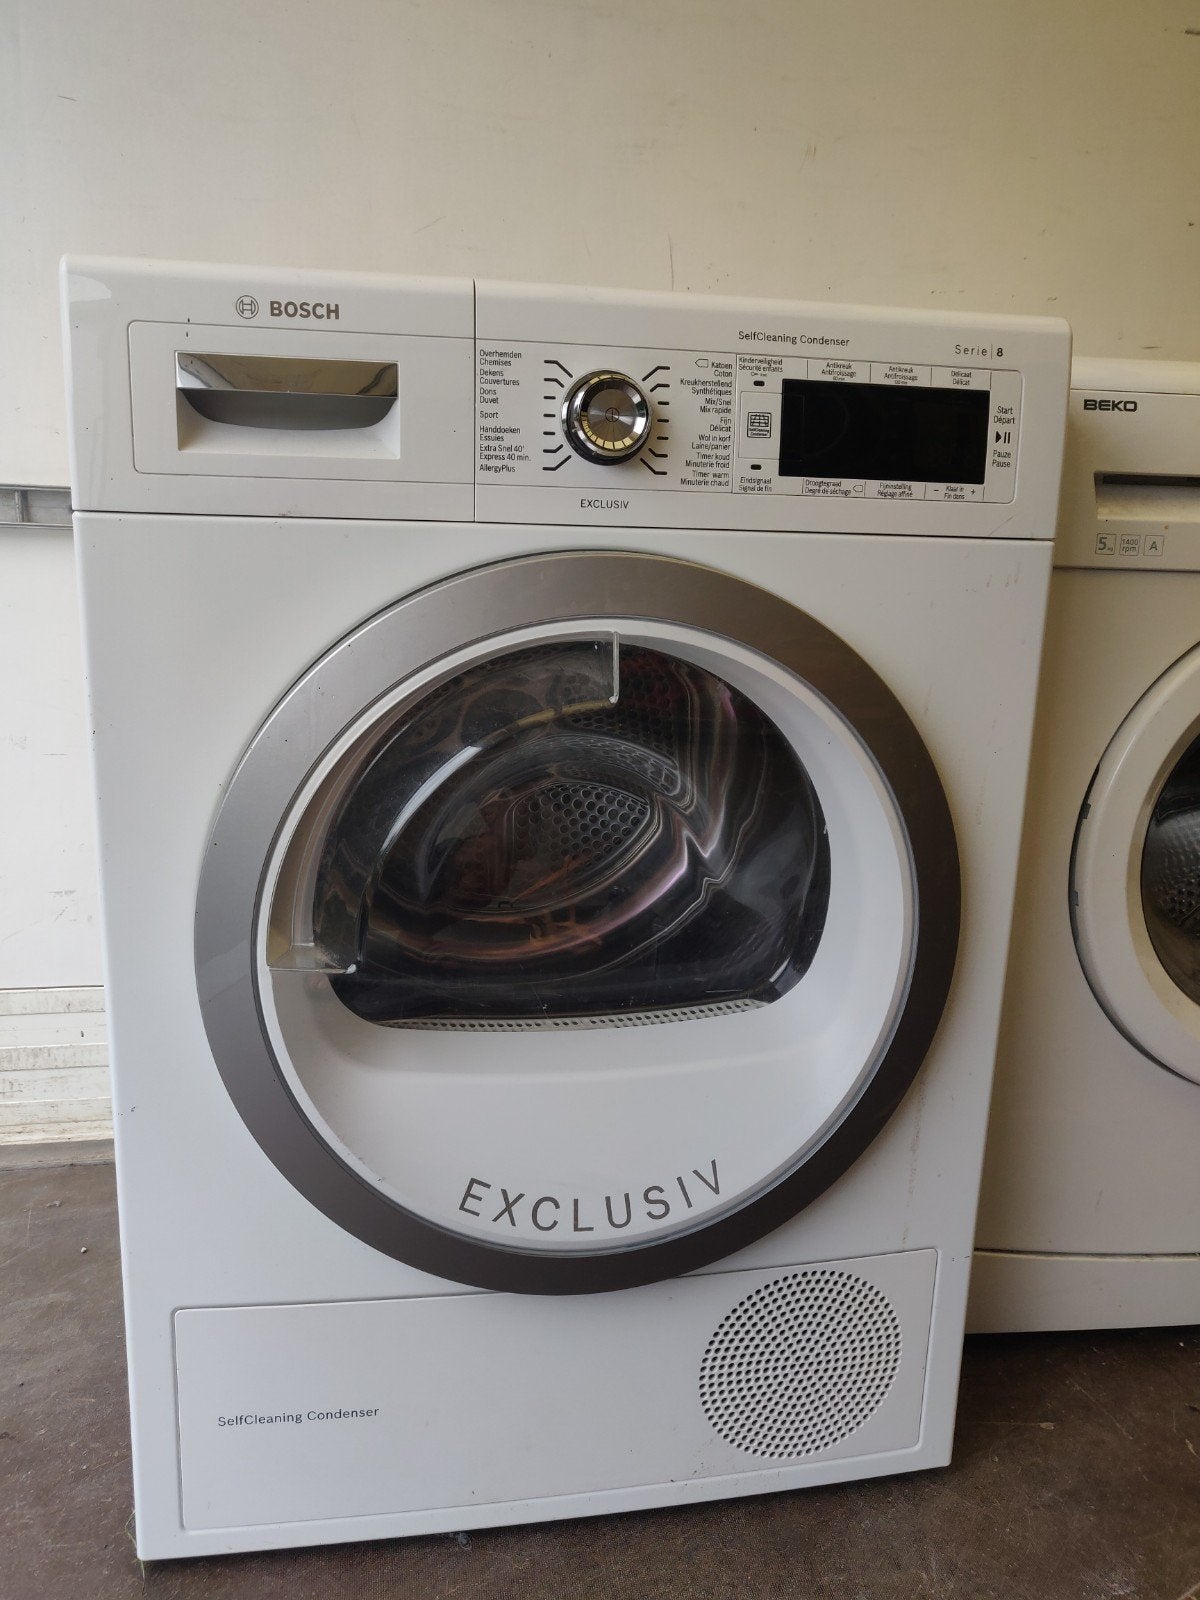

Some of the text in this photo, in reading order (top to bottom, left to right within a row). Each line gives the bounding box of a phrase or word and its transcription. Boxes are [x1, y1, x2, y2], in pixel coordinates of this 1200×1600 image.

[270, 300, 340, 320] BOSCH
[738, 331, 850, 346] SelfCleaning Condenser
[480, 349, 521, 358] Overhemden
[954, 345, 1003, 357] Serie 8
[711, 362, 732, 370] Katoen
[714, 370, 732, 378] Coton
[480, 377, 519, 385] Couvertures
[680, 378, 732, 388] Kreukherstellend
[692, 388, 732, 396] Synthétiques
[480, 396, 499, 404] Duvet
[705, 398, 732, 406] Mix/Snel
[997, 406, 1013, 414] Start
[1083, 399, 1137, 412] BEKO
[480, 411, 498, 420] Sport
[711, 407, 732, 416] rapide
[994, 415, 1015, 425] Départ
[480, 426, 520, 434] Handdoeken
[710, 424, 731, 432] Délicat
[480, 434, 504, 442] Essuies
[480, 444, 496, 452] Extra
[692, 442, 731, 452] Laine/panier
[480, 453, 505, 461] Express
[697, 452, 714, 460] Timer
[993, 449, 1011, 458] Pauze
[686, 460, 715, 468] Minuterie
[992, 459, 1011, 468] Pause
[479, 464, 515, 473] AllergyPlus
[692, 470, 710, 478] Timer
[680, 478, 710, 486] Minuterie
[580, 499, 630, 509] EXCLUSIV
[1098, 536, 1108, 550] 5
[1150, 541, 1158, 551] A
[1122, 545, 1137, 554] rpm
[458, 1158, 720, 1232] EXCLUSIV
[218, 1408, 380, 1427] SelfCleaning Condenser
